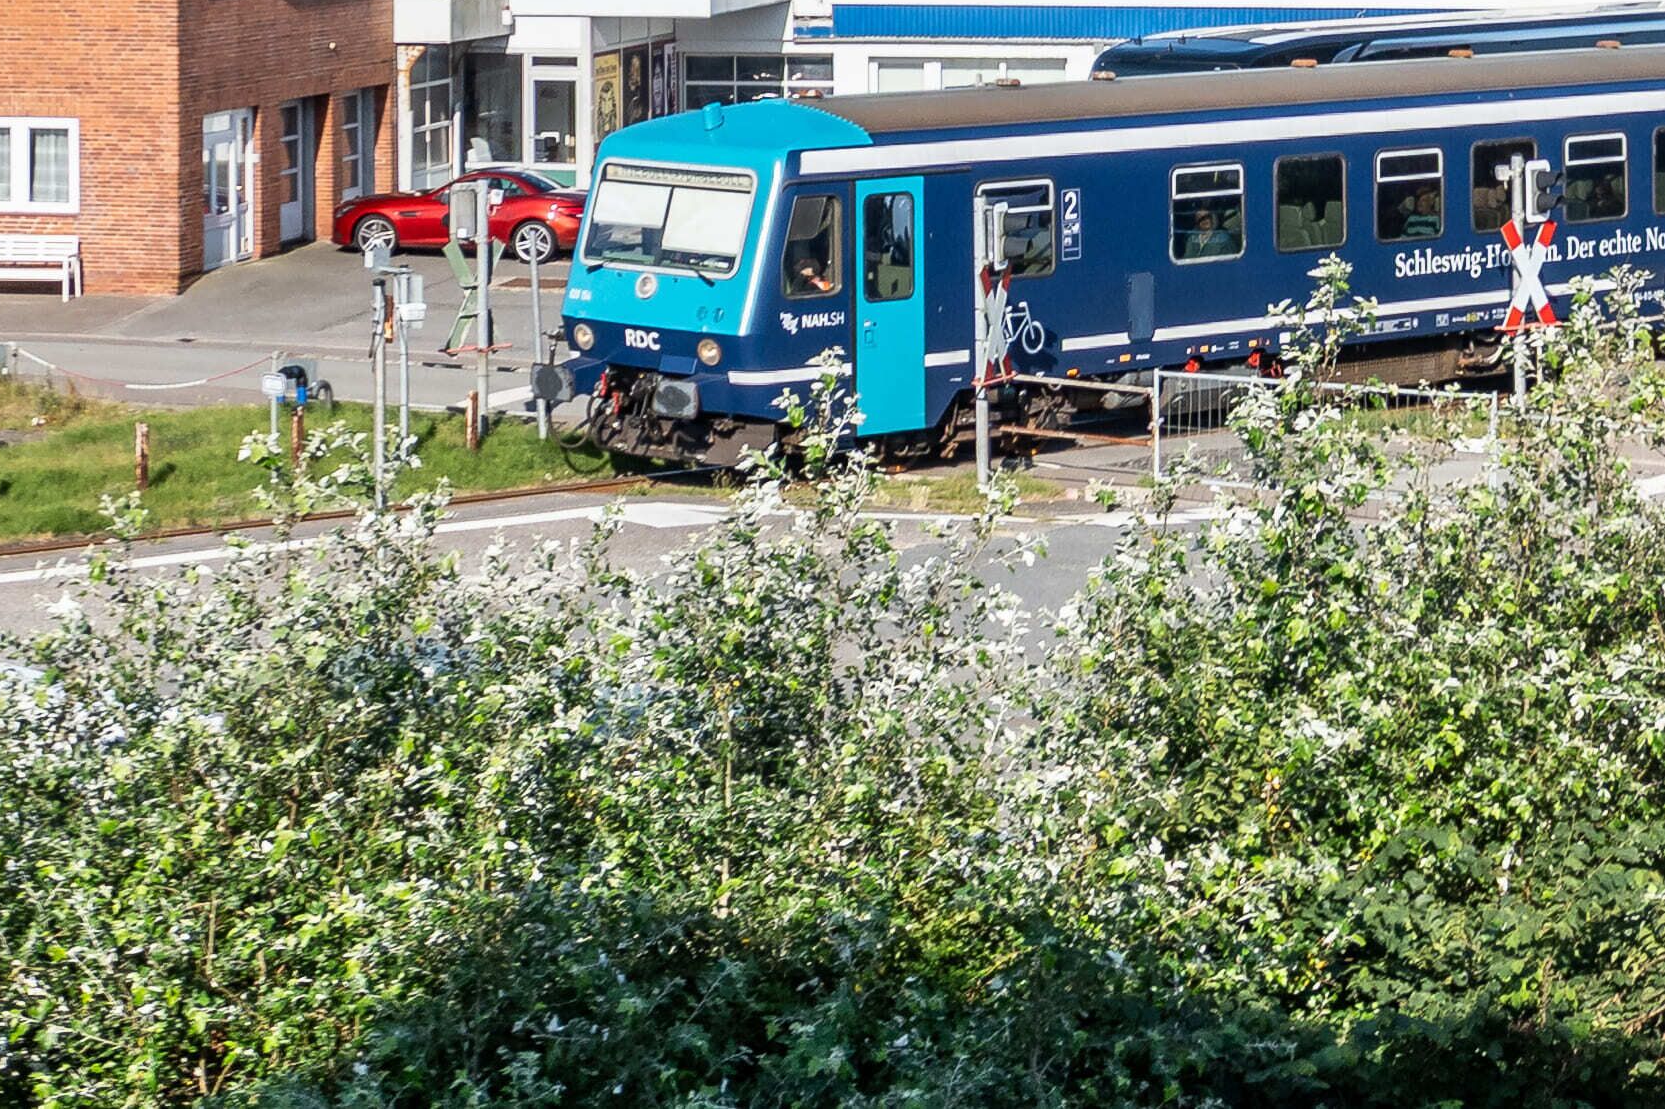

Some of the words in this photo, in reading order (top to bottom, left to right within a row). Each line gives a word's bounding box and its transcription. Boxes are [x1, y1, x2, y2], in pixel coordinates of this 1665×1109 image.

[1064, 191, 1078, 220] 2
[1394, 243, 1562, 278] Schleswig-Hon.
[1567, 236, 1596, 260] Der
[1599, 228, 1641, 257] echte
[624, 328, 661, 351] RDC
